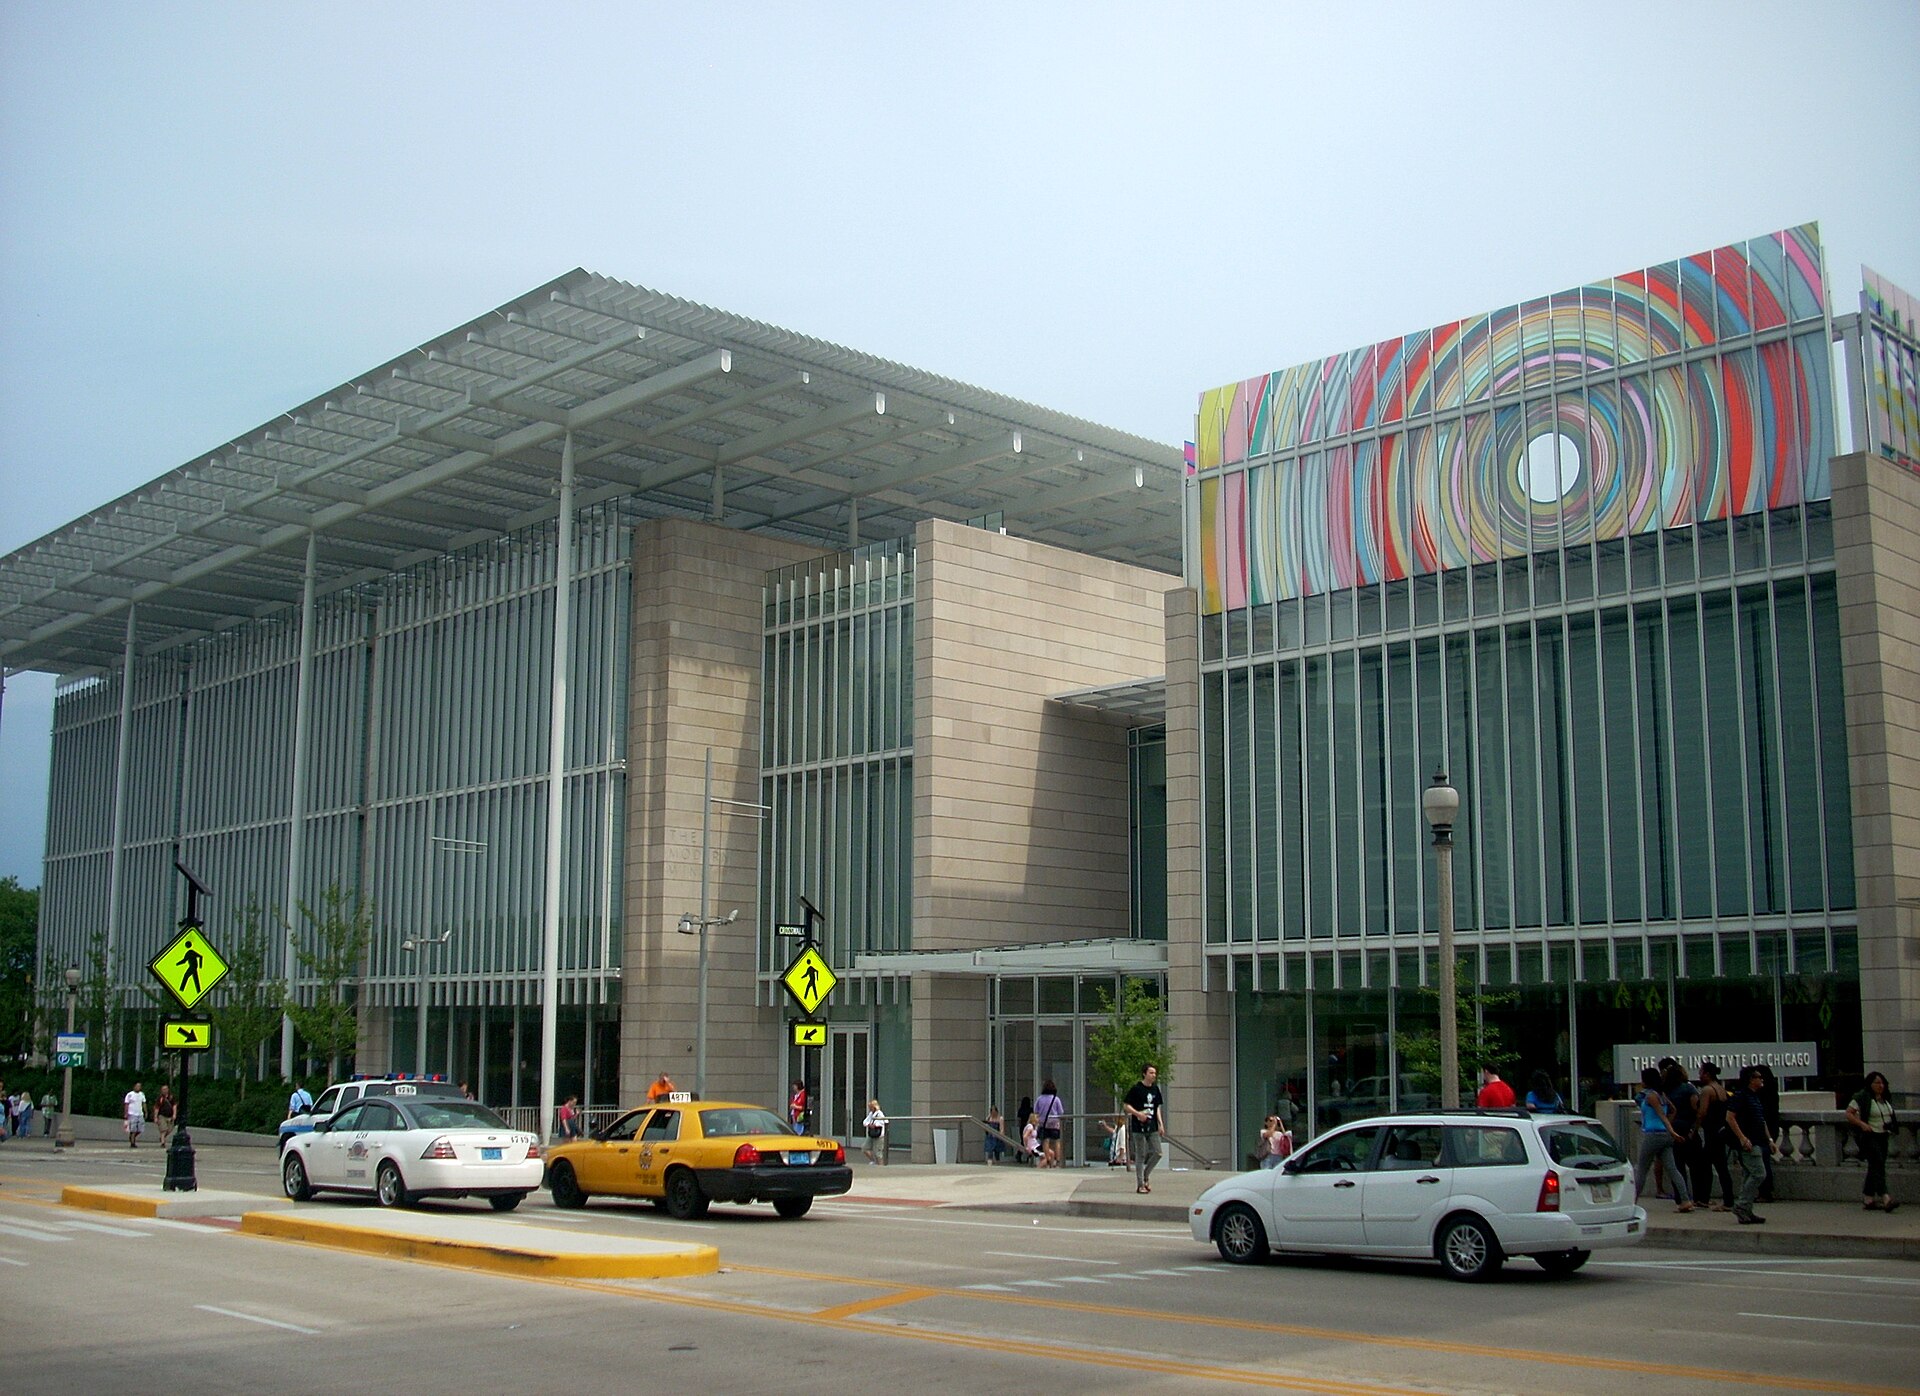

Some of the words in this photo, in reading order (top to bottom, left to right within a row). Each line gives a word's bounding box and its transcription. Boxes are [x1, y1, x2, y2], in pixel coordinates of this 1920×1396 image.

[669, 829, 697, 844] THE
[778, 926, 806, 936] CROSSWALK
[1751, 1053, 1764, 1067] OF
[1767, 1052, 1810, 1067] CHICAGO
[670, 1092, 691, 1101] 4877
